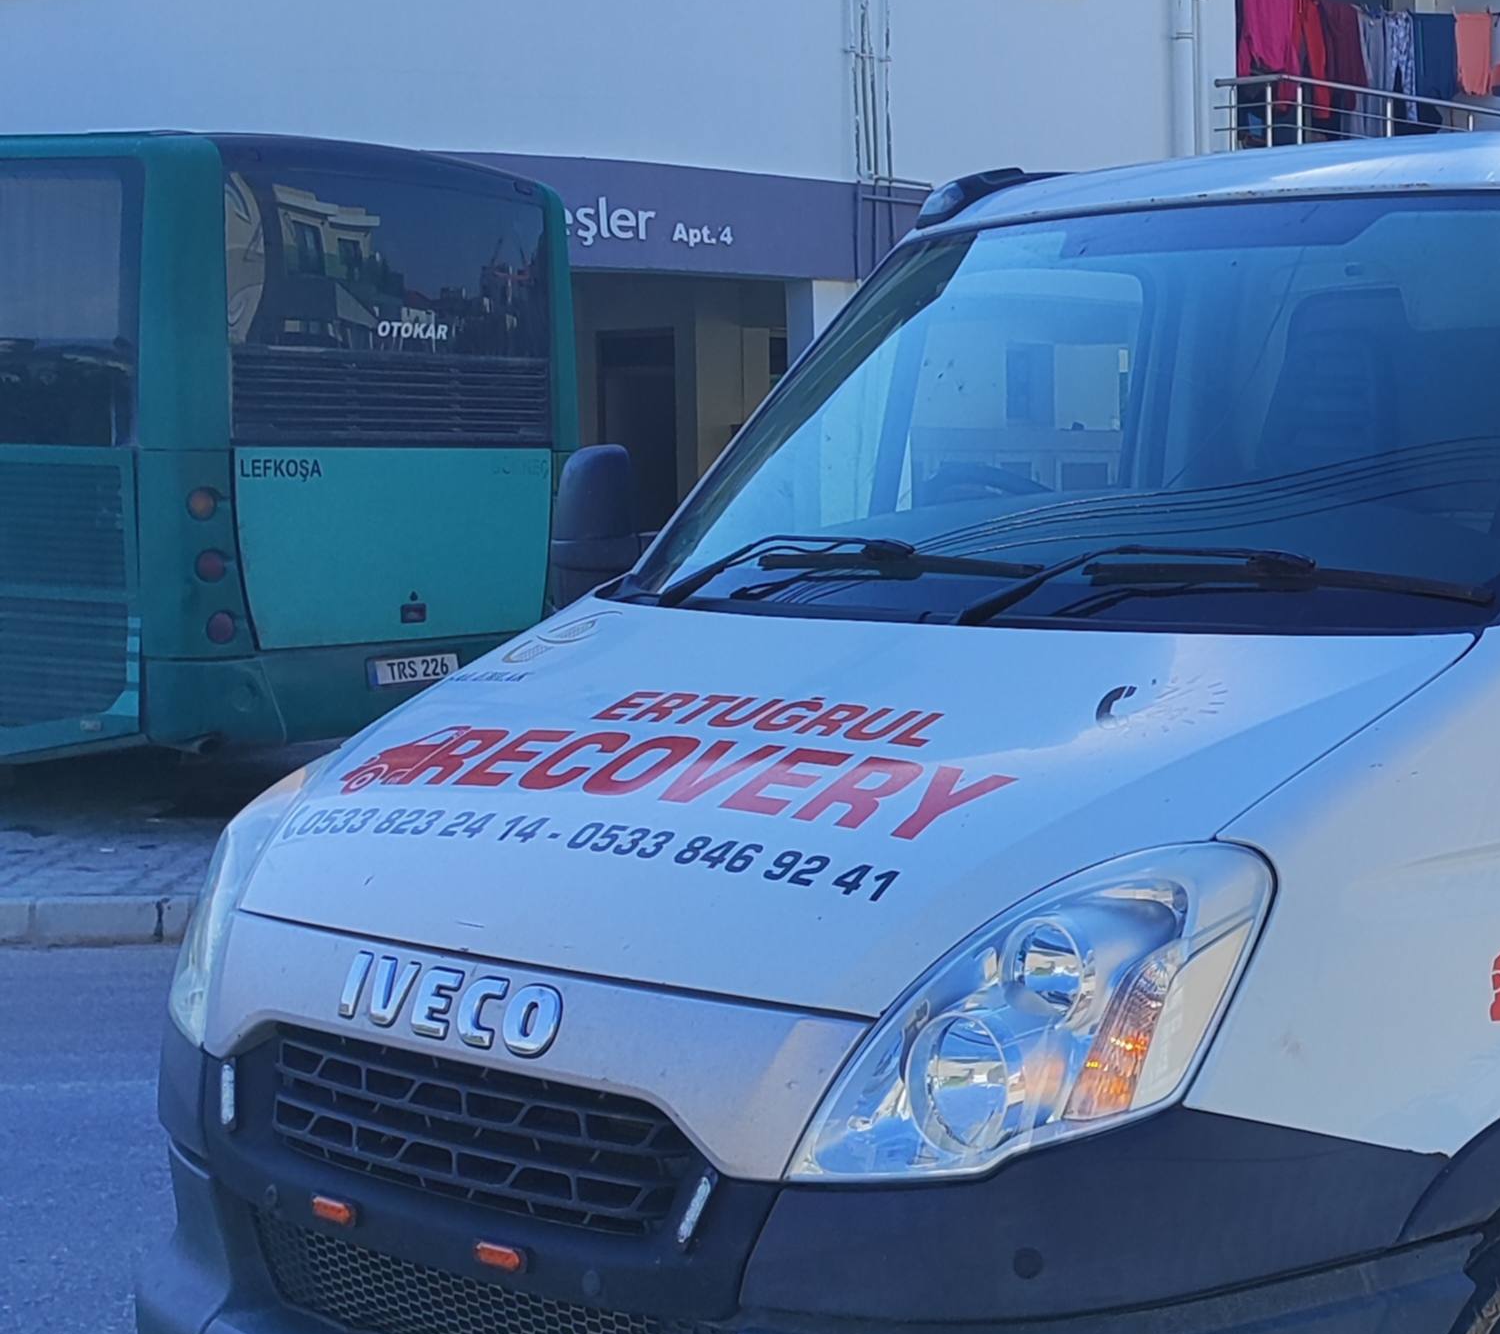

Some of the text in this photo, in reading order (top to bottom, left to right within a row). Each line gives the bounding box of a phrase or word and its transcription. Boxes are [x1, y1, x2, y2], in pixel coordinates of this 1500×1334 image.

[378, 321, 448, 340] OTOKAR
[240, 459, 322, 482] LEFKOŞA
[387, 661, 417, 681] TRS
[423, 656, 449, 679] 226
[402, 728, 1019, 841] RECOVERY
[300, 807, 380, 836] 0533
[373, 808, 446, 836] 823
[437, 811, 496, 839] 24
[497, 815, 550, 843] 14
[567, 822, 676, 859] 0533
[674, 836, 764, 873] 846
[763, 850, 831, 887] 92
[832, 864, 900, 902] 41
[338, 950, 564, 1059] IVECO
